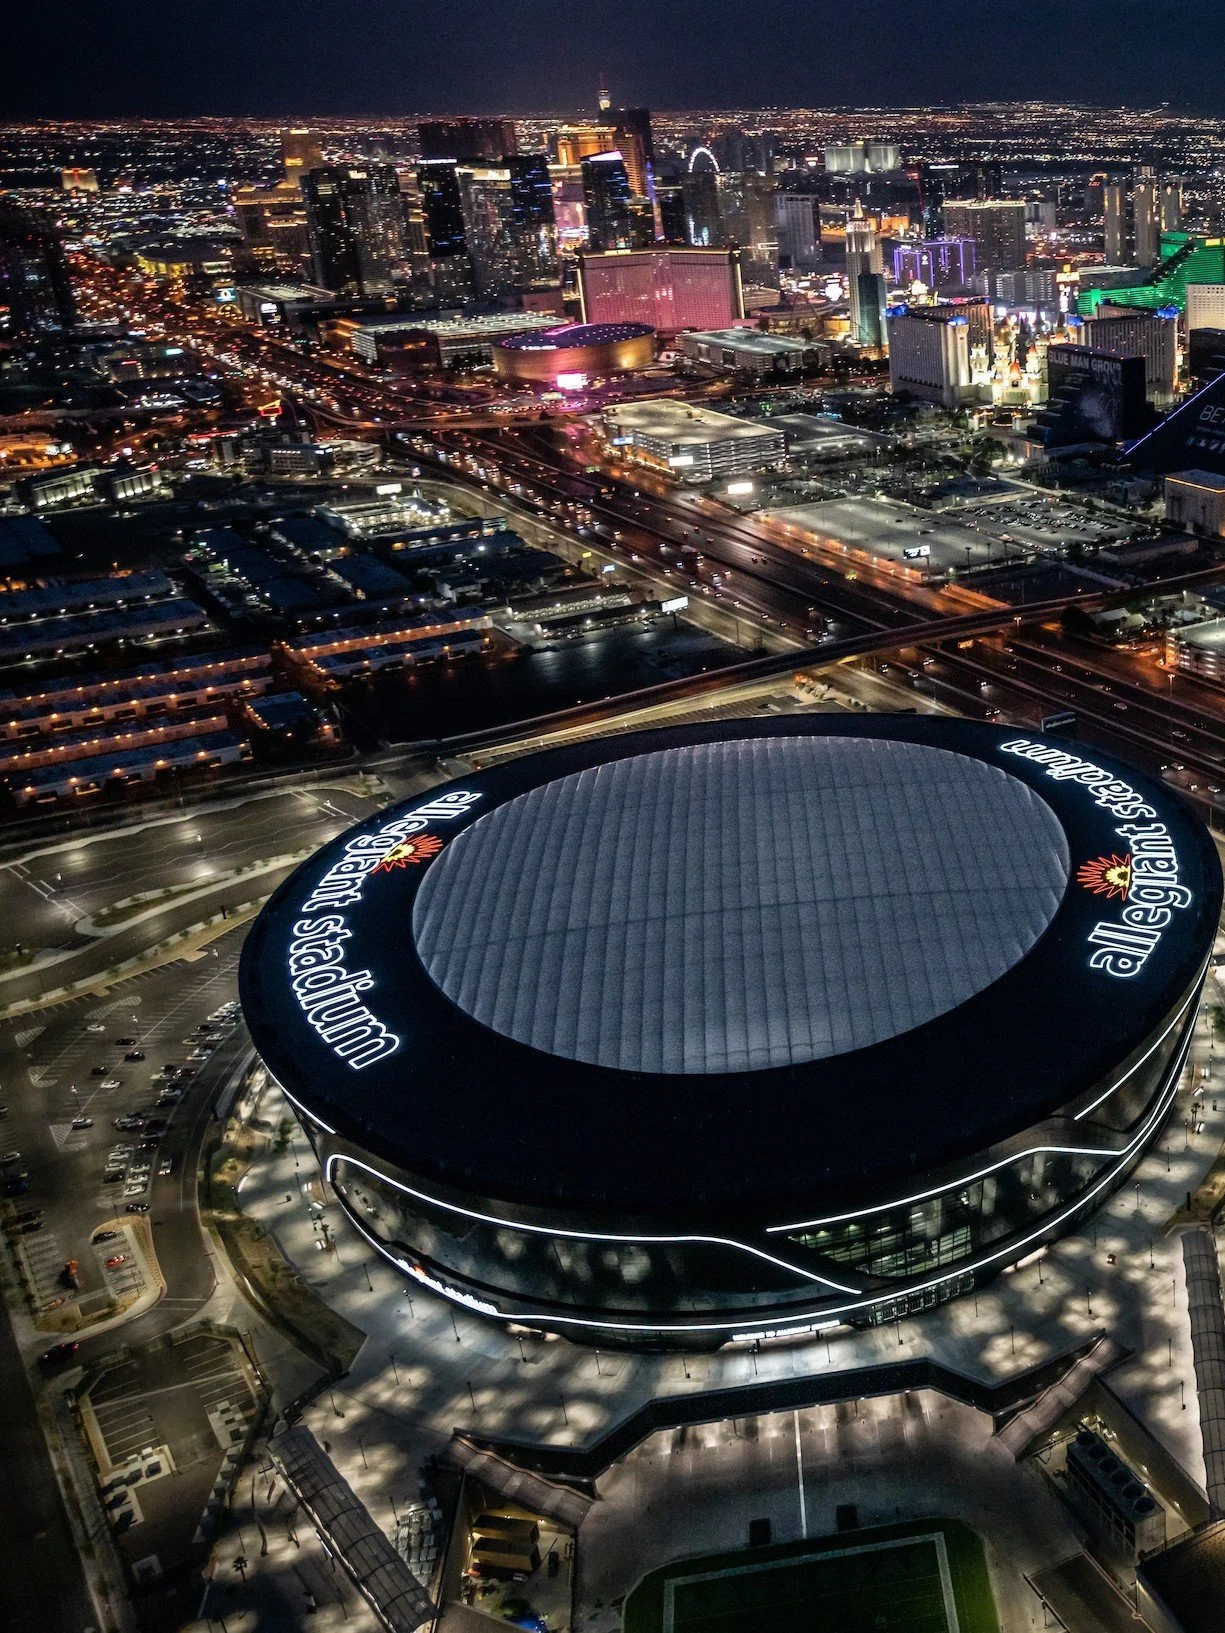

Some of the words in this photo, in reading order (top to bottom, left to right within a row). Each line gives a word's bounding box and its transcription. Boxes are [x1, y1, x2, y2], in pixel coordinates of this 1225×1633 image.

[1049, 350, 1069, 366] BLUE
[1070, 354, 1090, 370] MAN
[1091, 358, 1122, 374] GROUP
[1000, 739, 1157, 819] stadium
[302, 790, 484, 912] allegiant
[1088, 823, 1192, 977] allegiant
[288, 914, 401, 1070] stadium
